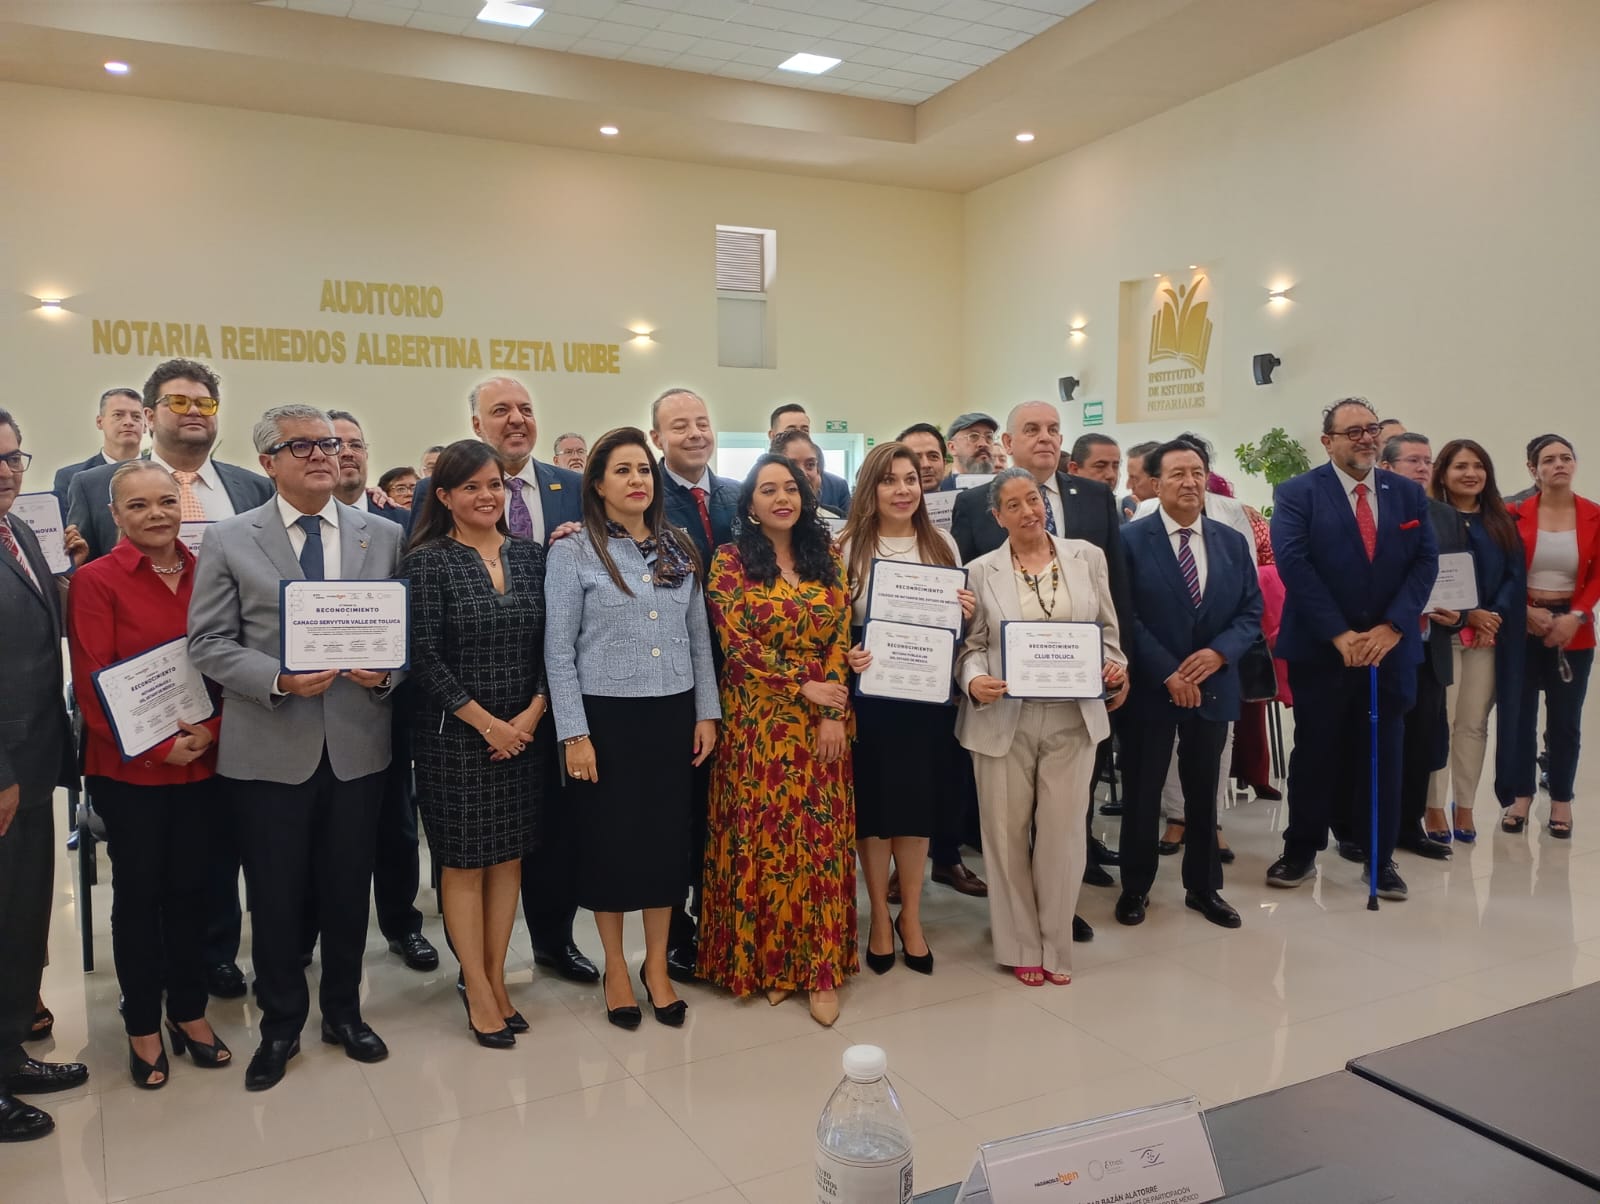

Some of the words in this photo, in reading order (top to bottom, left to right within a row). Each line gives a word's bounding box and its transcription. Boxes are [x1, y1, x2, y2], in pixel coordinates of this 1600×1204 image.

[320, 279, 443, 318] AUDITORIO
[92, 319, 212, 358] NOTARIA
[220, 326, 347, 365] REMEDIOS
[355, 332, 483, 369] ALBERTINA
[489, 339, 557, 372] EZETA
[563, 342, 620, 374] URIBE
[1149, 367, 1196, 384] INSTITUTO
[1149, 386, 1160, 397] DE
[1161, 382, 1204, 396] ESTUDIOS
[1148, 396, 1205, 412] NOTARIALES
[1058, 1171, 1079, 1183] bien
[1125, 1185, 1158, 1199] ALATORRE
[1150, 1186, 1191, 1203] PARTICIPACIÓN
[1179, 1192, 1199, 1203] MÉXICO
